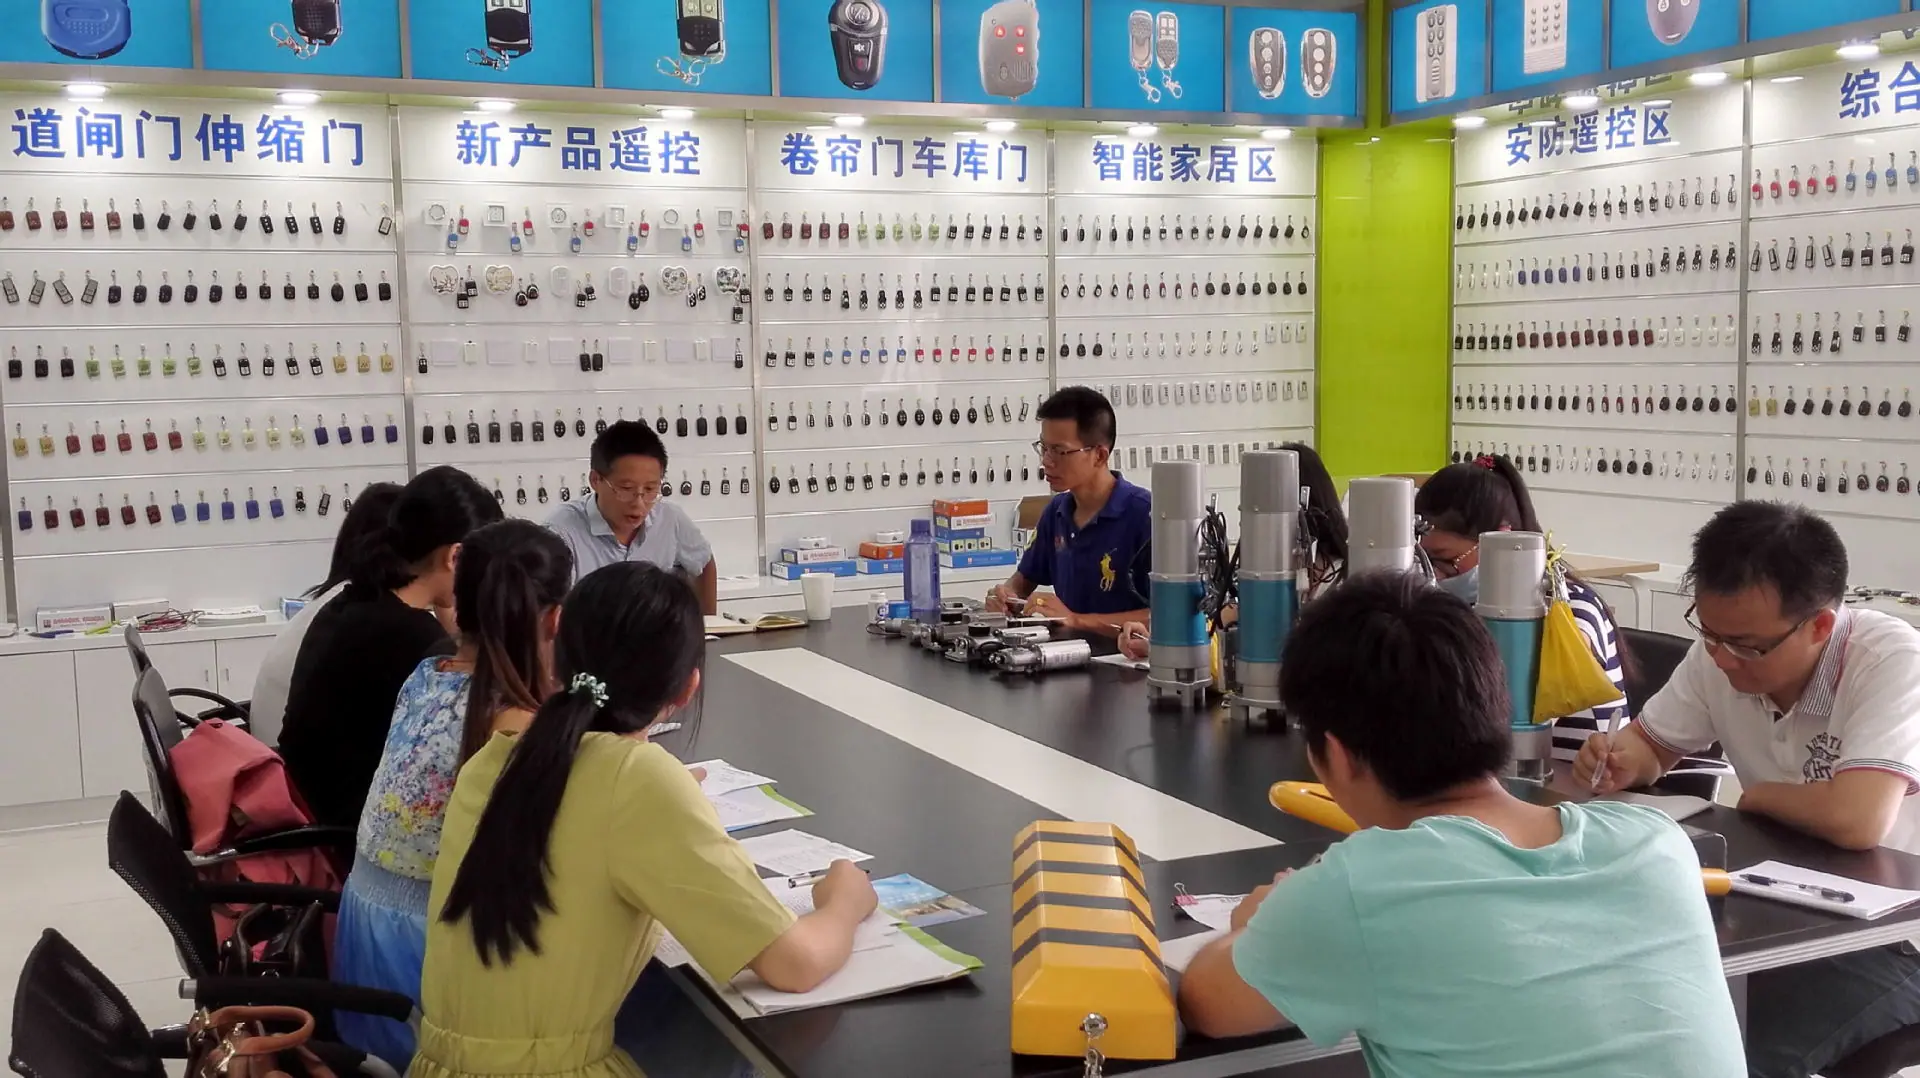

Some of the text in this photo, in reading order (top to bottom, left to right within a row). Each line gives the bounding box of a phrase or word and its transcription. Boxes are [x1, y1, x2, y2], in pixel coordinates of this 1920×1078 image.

[1839, 61, 1920, 119] 综合
[12, 107, 364, 167] 道闸门伸缩门
[456, 121, 701, 175] 新产品遥控
[781, 132, 1028, 182] 卷帘门车库门
[1093, 140, 1277, 183] 智能家居区
[1506, 105, 1672, 166] 安防遥控区
